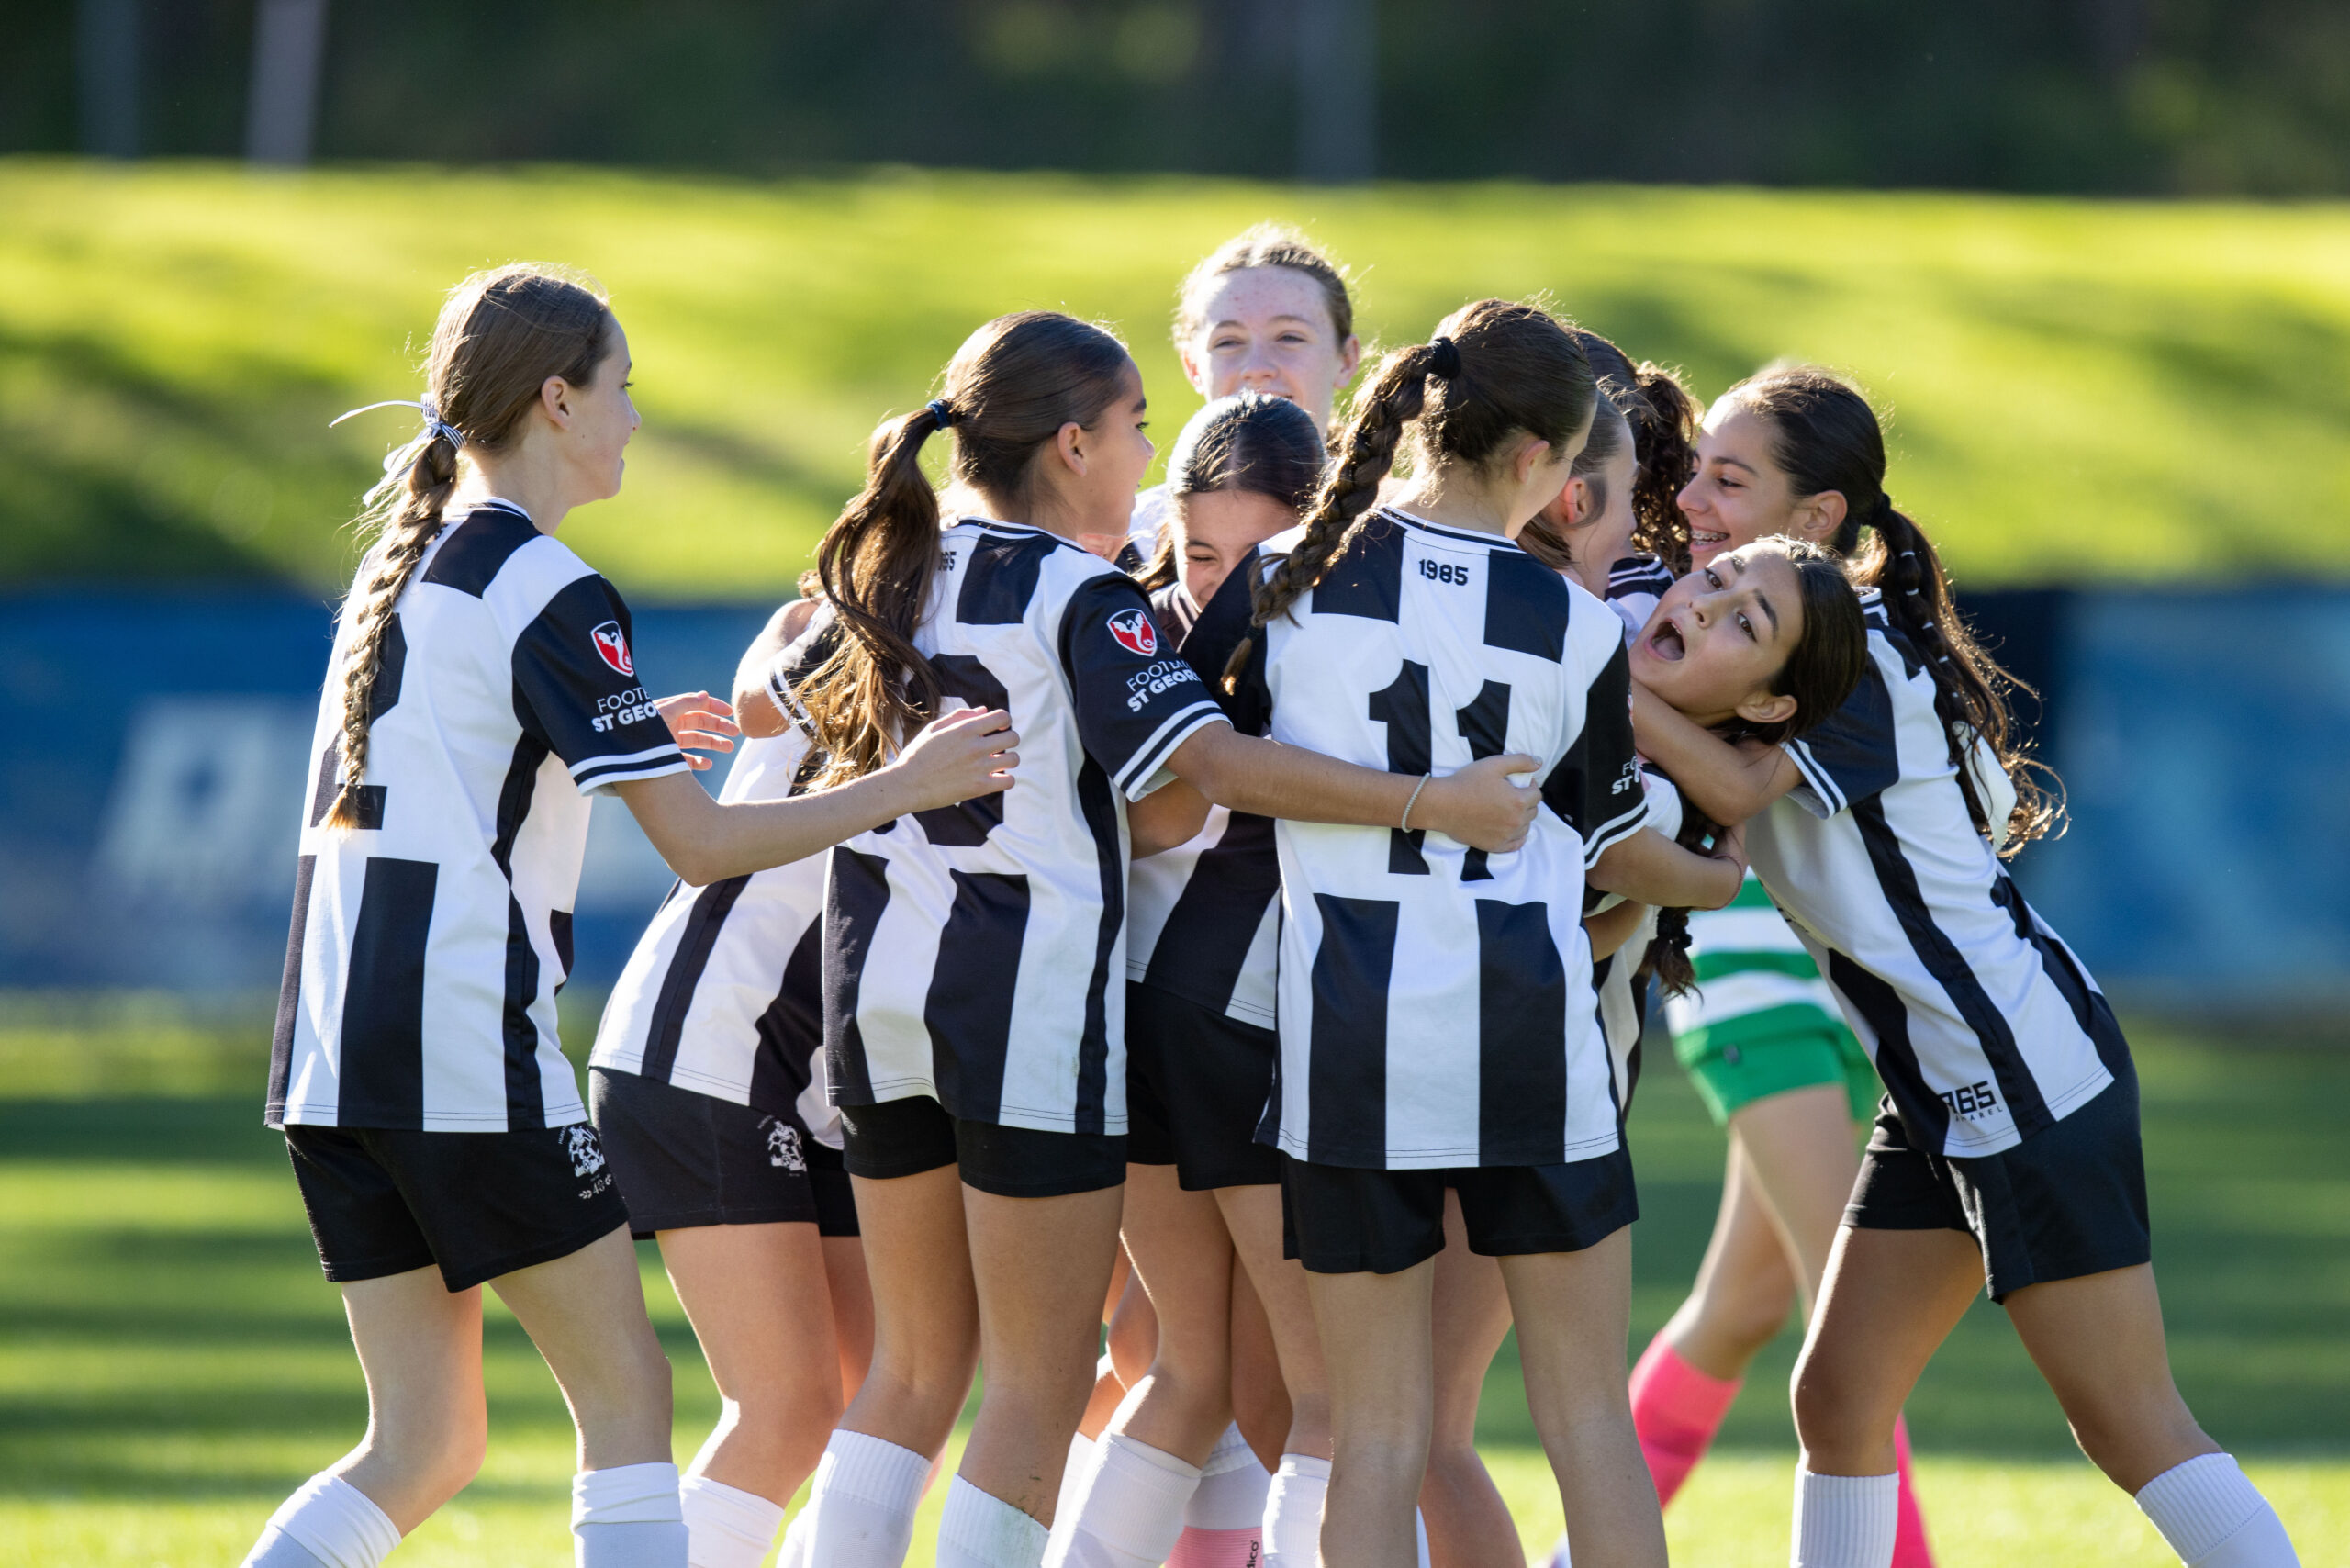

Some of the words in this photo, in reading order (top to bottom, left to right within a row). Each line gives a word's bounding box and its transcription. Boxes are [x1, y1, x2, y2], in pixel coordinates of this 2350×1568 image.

[1418, 558, 1469, 587] 1985
[1127, 688, 1150, 712] ST
[591, 713, 614, 733] ST
[618, 701, 661, 725] GEO
[1369, 658, 1512, 882] 11
[1611, 775, 1633, 795] ST
